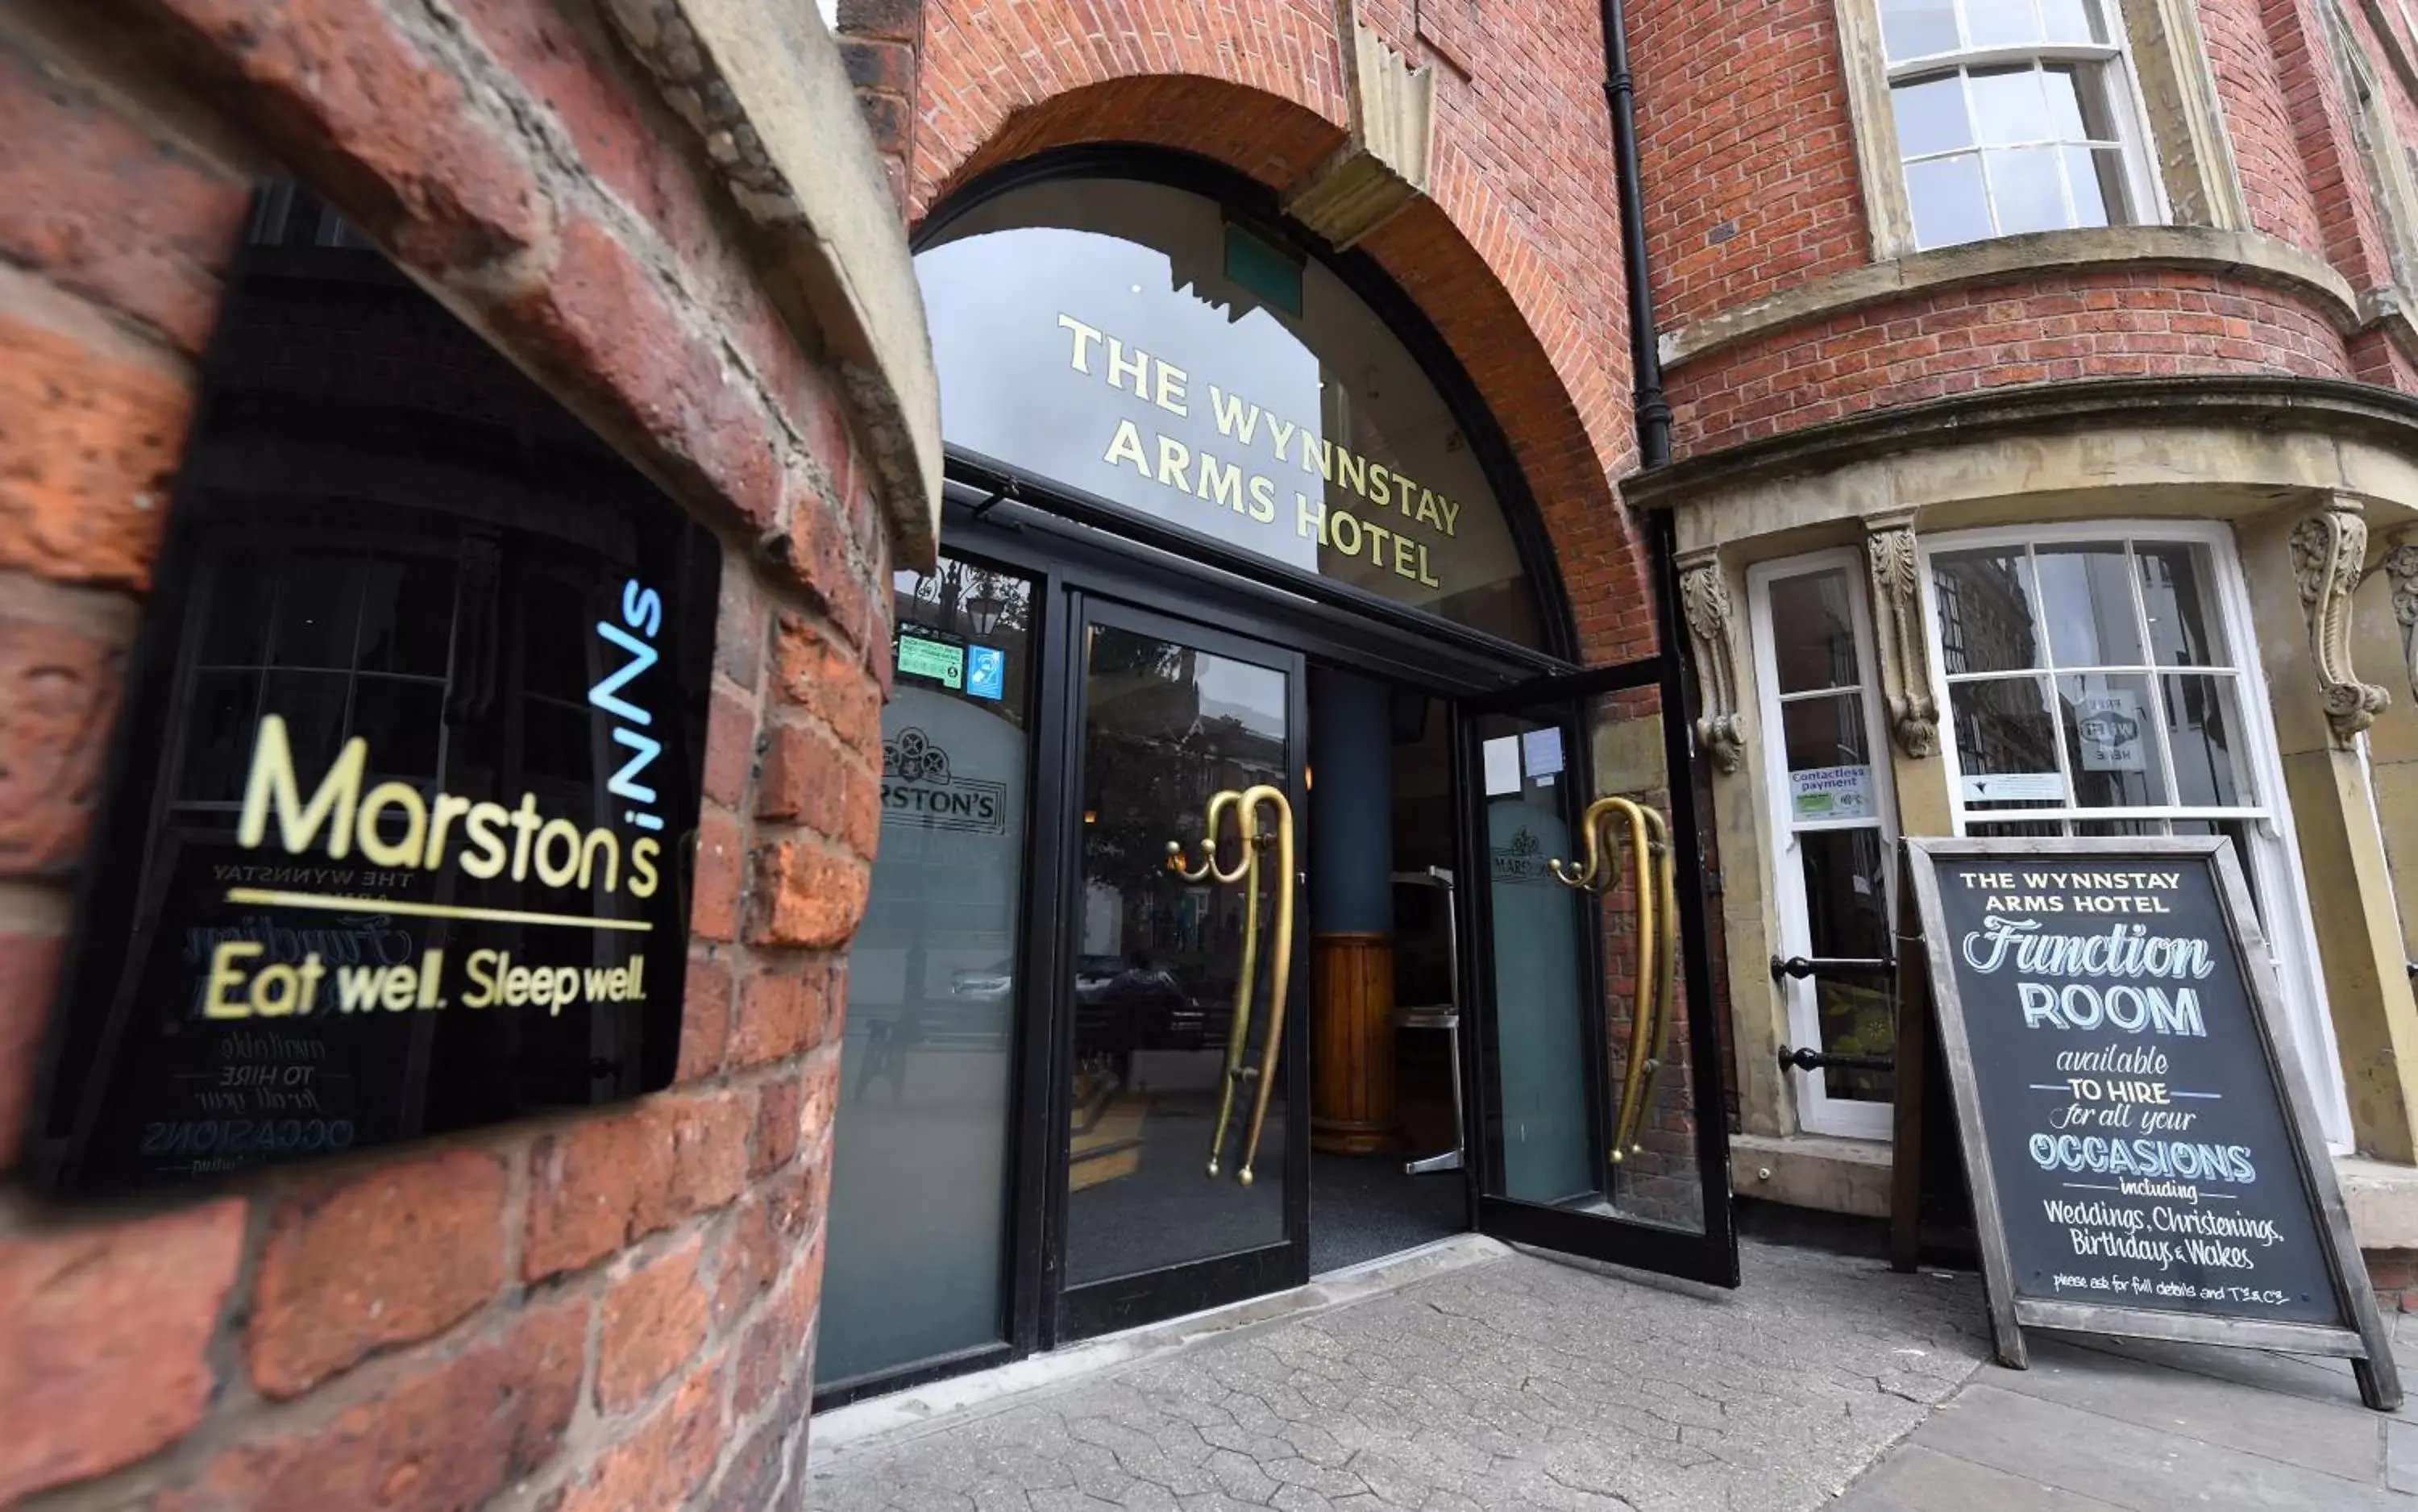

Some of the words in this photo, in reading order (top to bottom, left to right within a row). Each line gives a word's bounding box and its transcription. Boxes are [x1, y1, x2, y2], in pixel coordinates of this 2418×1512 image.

[1057, 313, 1189, 418] THE
[1208, 384, 1461, 538] WYNNSTAY
[1103, 417, 1276, 525] ARMS
[1294, 491, 1441, 589] HOTEL
[1793, 768, 1864, 783] Contactless
[1802, 778, 1857, 791] payment
[1959, 872, 2017, 890] THE
[2022, 872, 2180, 890] WYNNSTAY
[1985, 895, 2065, 914] ARMS
[2072, 895, 2171, 914] HOTEL
[1962, 915, 2215, 978] Function
[204, 941, 325, 1018] Eat
[462, 949, 580, 1016] Sleep
[2017, 982, 2207, 1037] ROOM
[2056, 1044, 2169, 1075] available
[2068, 1078, 2100, 1101] TO
[2108, 1081, 2171, 1104] HIRE
[2050, 1103, 2095, 1128] for
[2100, 1103, 2131, 1128] all
[2141, 1109, 2196, 1135] your
[2029, 1133, 2256, 1182] OCCASIONS
[2119, 1176, 2199, 1204] including
[2152, 1206, 2284, 1247] Christenings,
[2070, 1227, 2173, 1270] Birthdays
[2185, 1238, 2254, 1269] Wakes
[2053, 1273, 2088, 1292] please
[2090, 1276, 2111, 1290] ask
[2112, 1274, 2129, 1294] for
[2132, 1276, 2153, 1295] full
[2156, 1280, 2196, 1297] details
[2200, 1286, 2225, 1301] and
